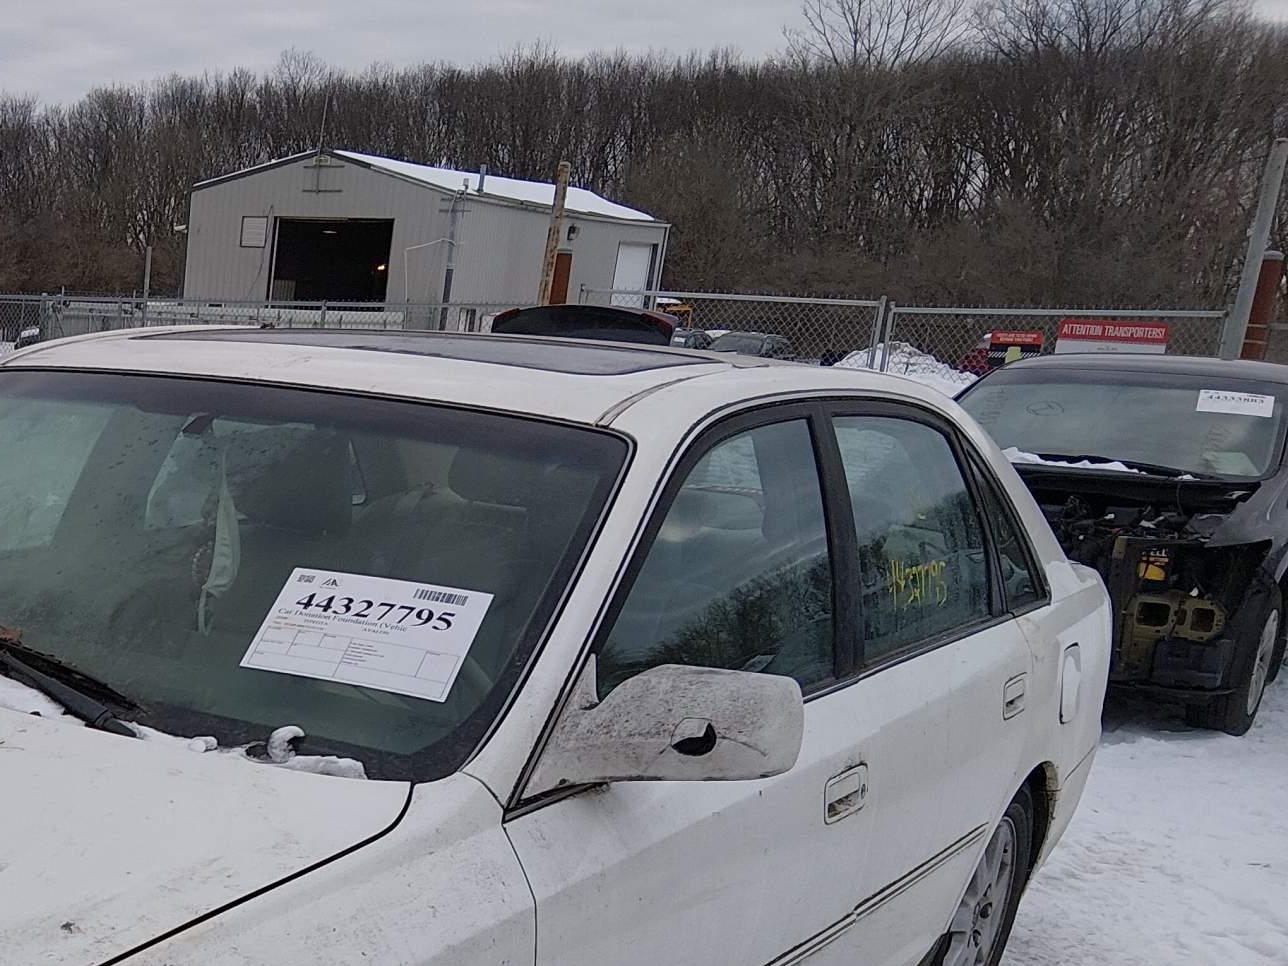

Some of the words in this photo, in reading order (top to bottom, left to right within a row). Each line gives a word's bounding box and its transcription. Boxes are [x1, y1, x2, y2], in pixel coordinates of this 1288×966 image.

[1062, 323, 1103, 336] ATTENTION
[1104, 325, 1167, 339] TRANSPORTERS!
[278, 607, 293, 615] Car
[293, 609, 332, 620] Donation
[332, 615, 379, 628] Foundation
[295, 592, 457, 632] 44327795
